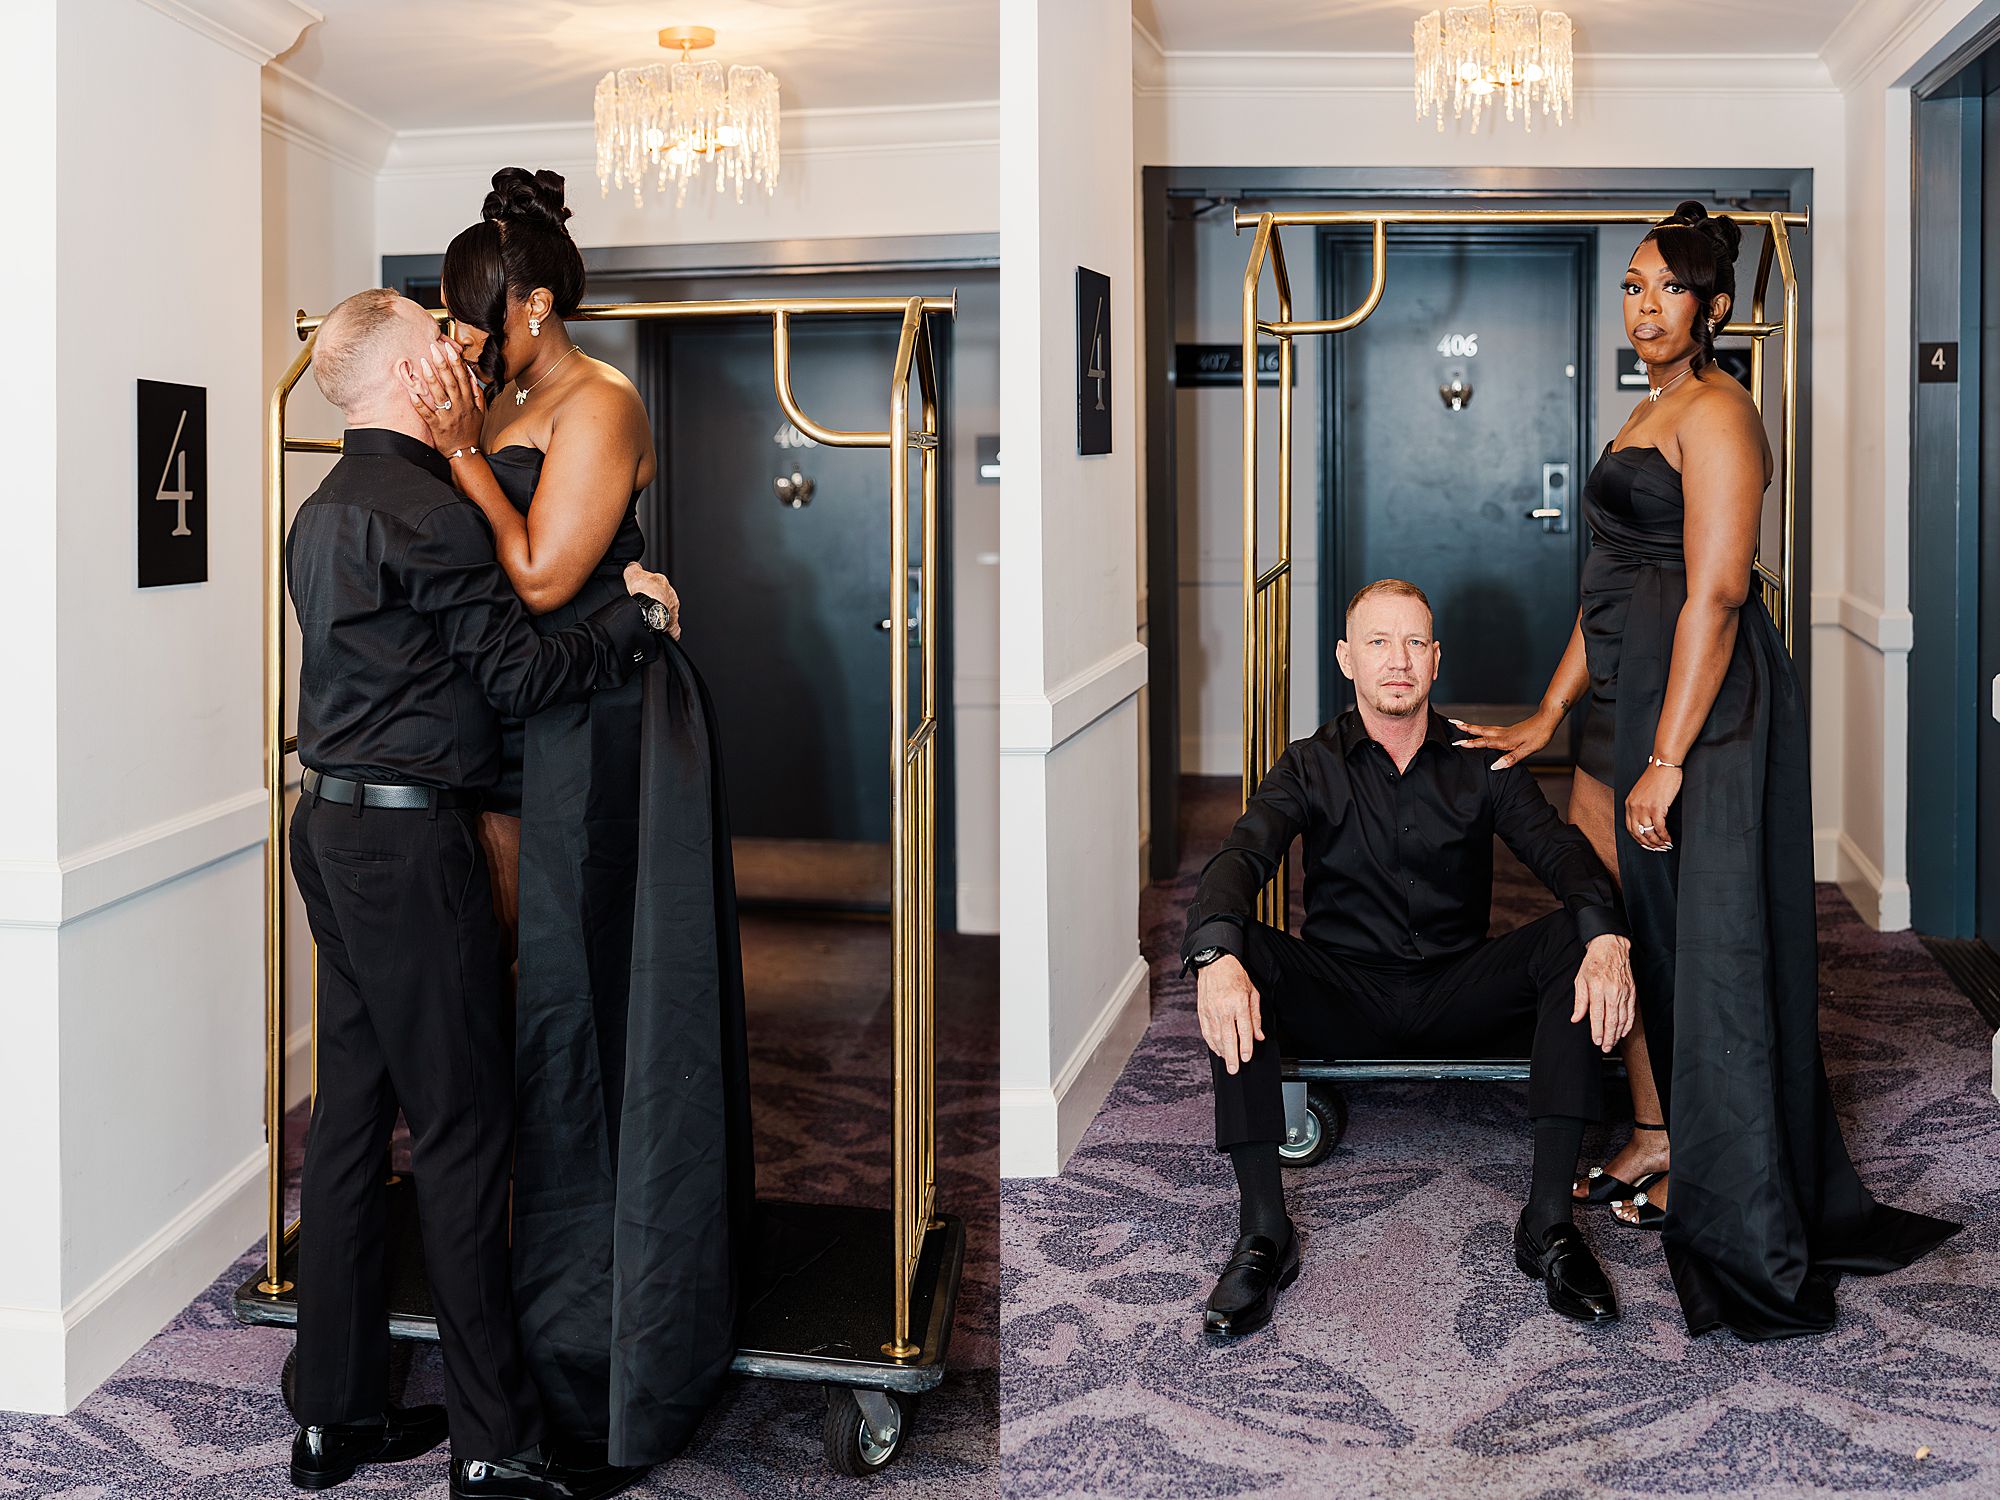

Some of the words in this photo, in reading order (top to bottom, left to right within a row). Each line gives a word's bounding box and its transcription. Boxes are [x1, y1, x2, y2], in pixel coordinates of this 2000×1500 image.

[1087, 296, 1106, 411] 4
[1437, 333, 1479, 357] 406
[1931, 347, 1946, 371] 4
[155, 409, 194, 537] 4
